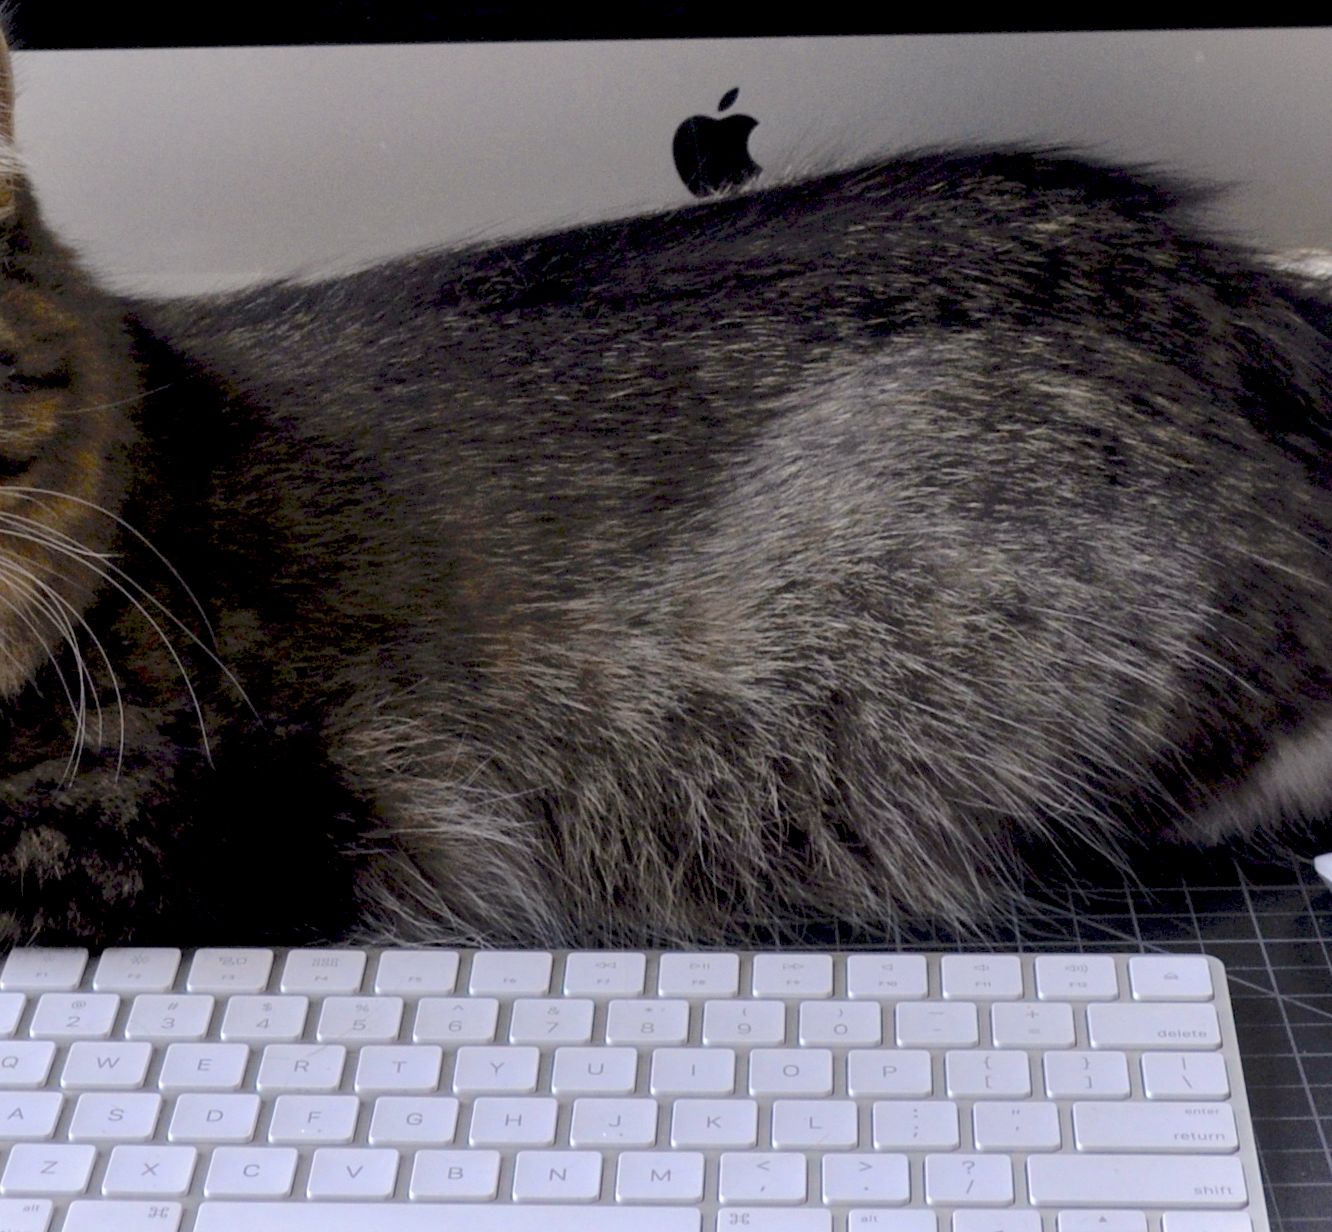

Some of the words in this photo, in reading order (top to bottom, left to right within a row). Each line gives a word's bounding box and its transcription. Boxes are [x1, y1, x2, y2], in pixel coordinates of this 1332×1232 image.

[65, 1015, 81, 1028] 2
[160, 1017, 176, 1030] 3
[255, 1018, 270, 1030] 4
[351, 1018, 367, 1031] 5
[447, 1020, 463, 1033] 6
[547, 1021, 560, 1034] 7
[640, 1022, 655, 1034] 8
[737, 1023, 752, 1035] 9
[832, 1023, 849, 1036] 0
[1156, 1029, 1208, 1038] delete
[0, 1055, 20, 1069] Q
[96, 1056, 121, 1070] W
[196, 1058, 211, 1071] E
[293, 1059, 310, 1073] R
[392, 1060, 407, 1074] T
[490, 1061, 505, 1075] Y
[587, 1063, 605, 1076] U
[882, 1065, 898, 1078] P
[7, 1107, 24, 1120] A
[107, 1107, 125, 1122] S
[205, 1109, 224, 1123] D
[307, 1111, 322, 1124] F
[1184, 1107, 1219, 1116] enter
[405, 1112, 423, 1126] G
[504, 1114, 523, 1127] H
[608, 1114, 622, 1128] J
[706, 1116, 721, 1129] K
[808, 1116, 822, 1130] L
[1173, 1131, 1226, 1141] return
[39, 1160, 59, 1175] Z
[141, 1162, 160, 1176] X
[242, 1163, 261, 1178] C
[346, 1165, 364, 1179] V
[447, 1166, 464, 1180] B
[548, 1167, 567, 1182] N
[650, 1168, 672, 1182] M
[1193, 1185, 1233, 1196] shift
[22, 1204, 41, 1213] alt
[860, 1214, 878, 1223] alt
